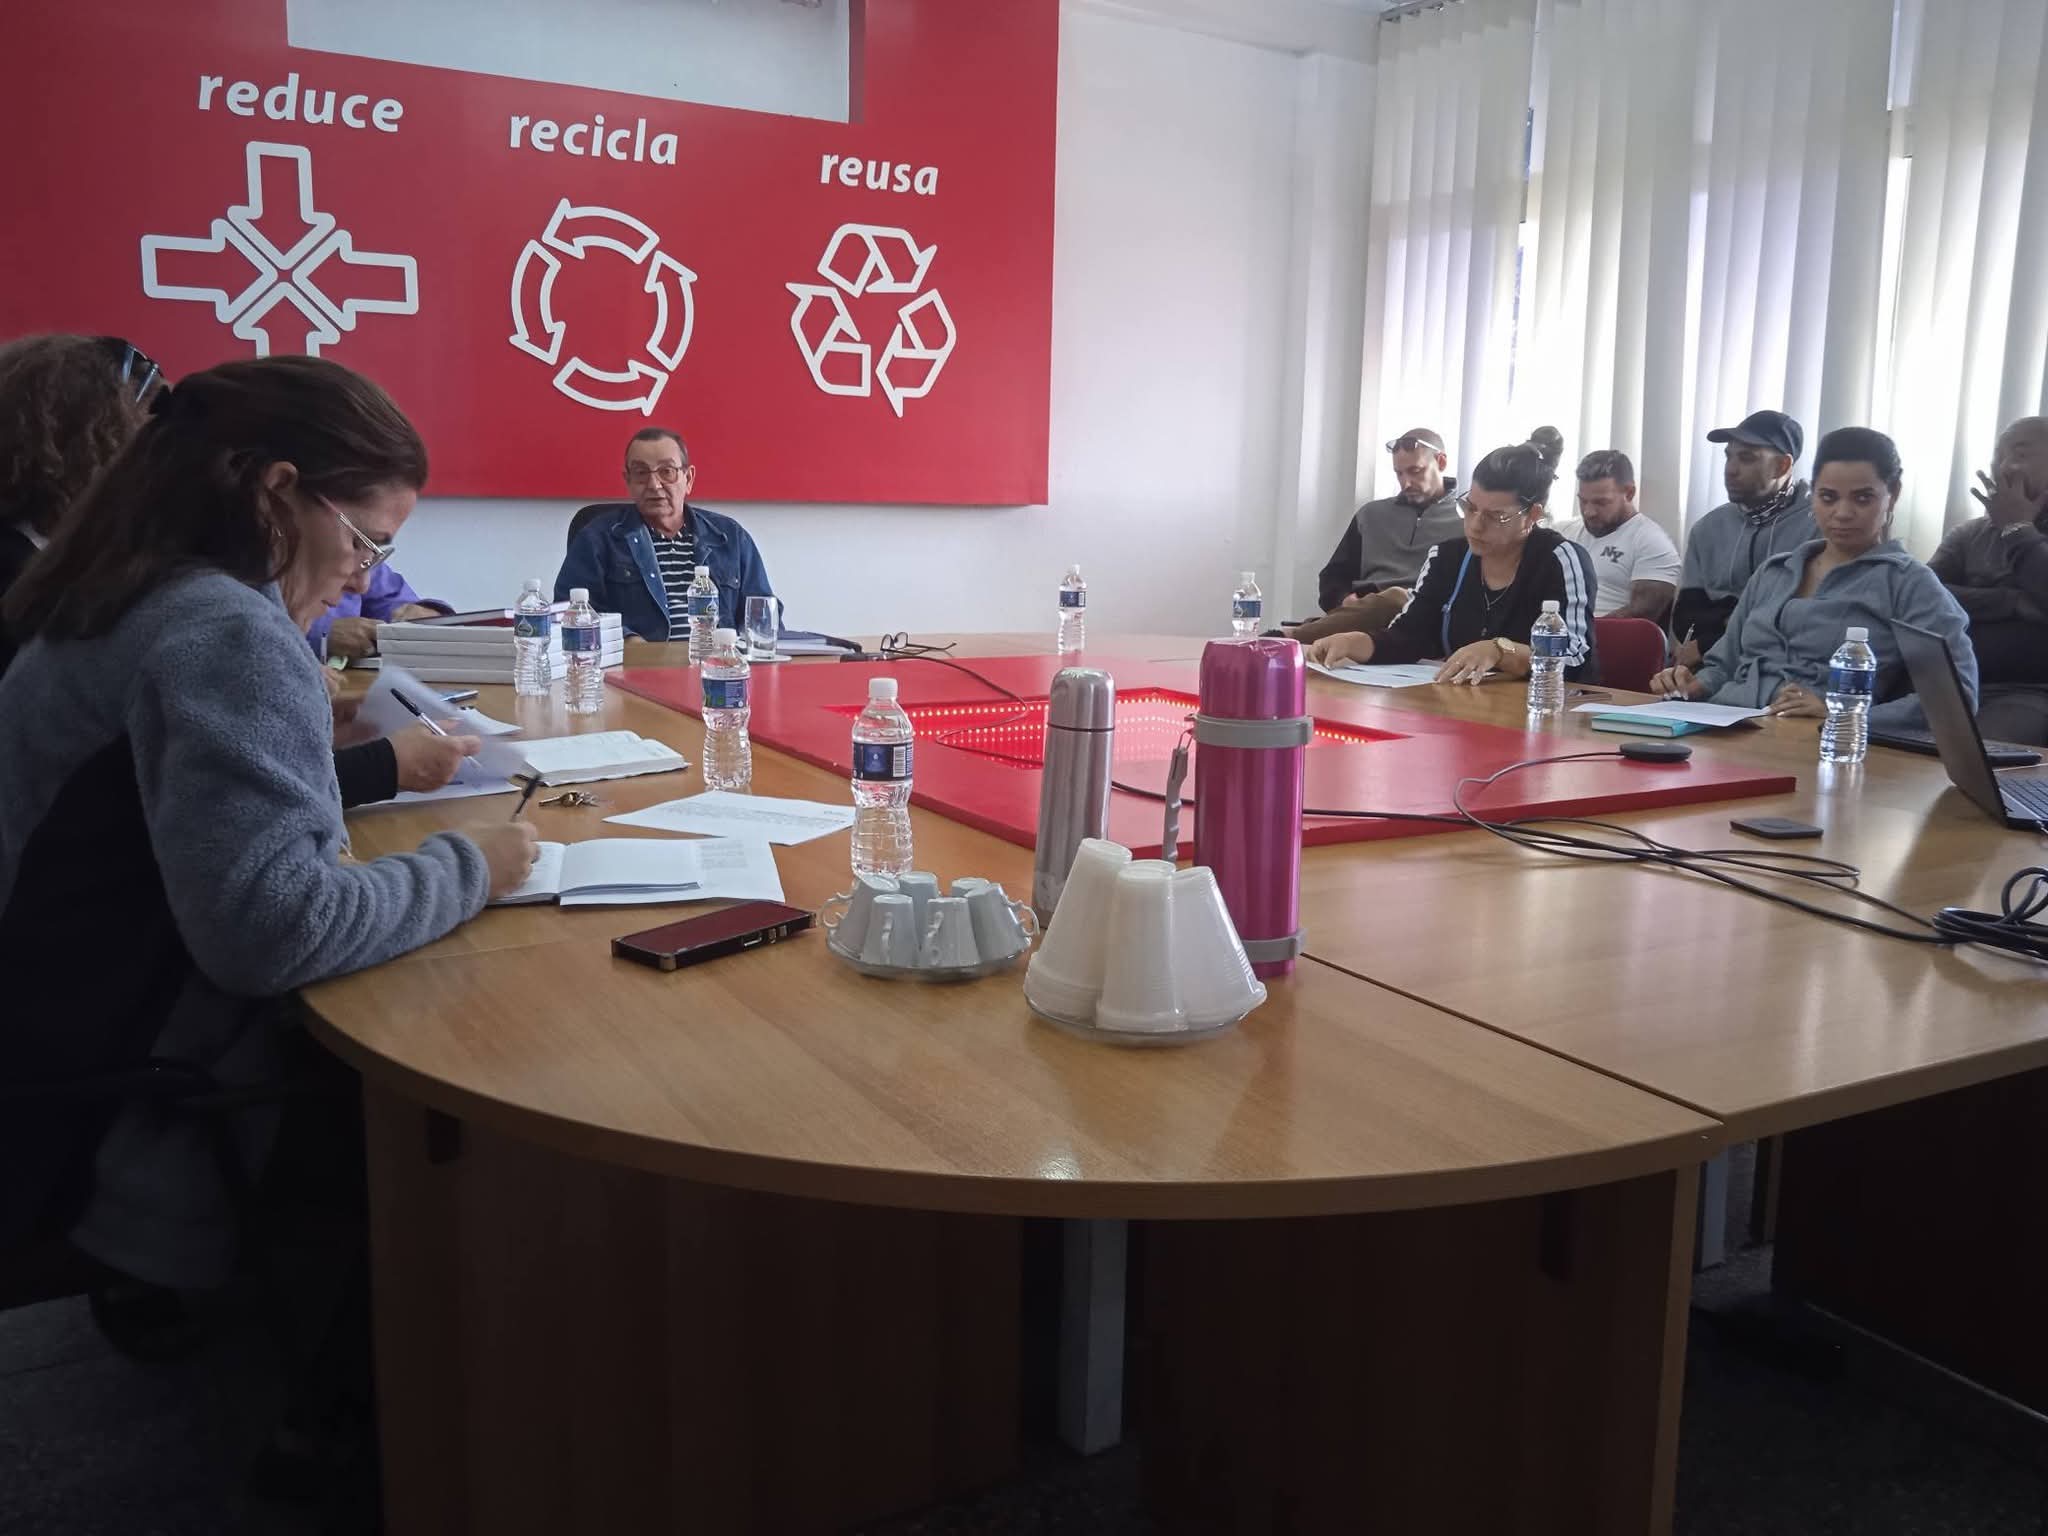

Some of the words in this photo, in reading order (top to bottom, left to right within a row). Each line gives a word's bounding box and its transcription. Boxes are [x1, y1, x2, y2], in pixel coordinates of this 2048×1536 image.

[198, 73, 404, 133] reduce
[510, 113, 679, 165] recicla
[820, 154, 940, 196] reusa
[1600, 546, 1624, 563] NY
